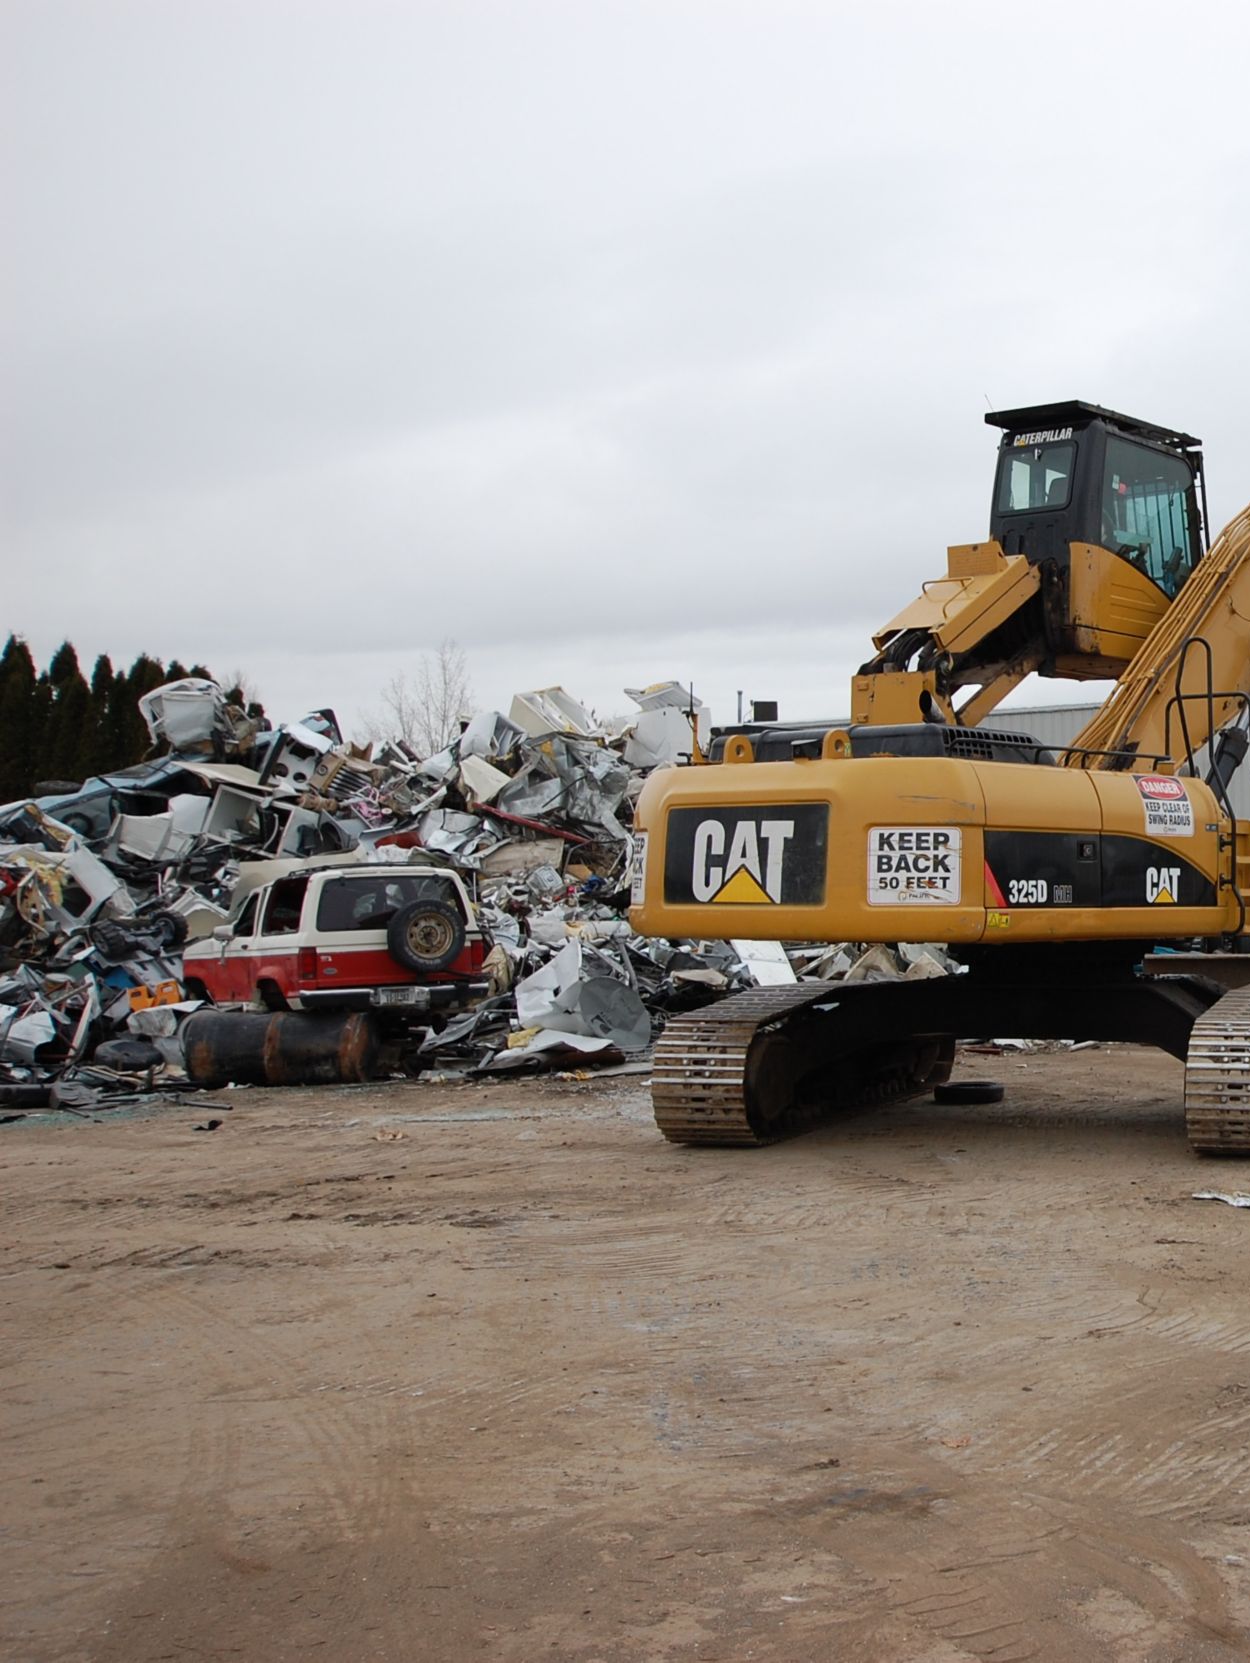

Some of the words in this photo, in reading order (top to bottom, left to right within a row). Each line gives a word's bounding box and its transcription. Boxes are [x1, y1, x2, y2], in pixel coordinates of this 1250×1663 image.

[1014, 427, 1073, 446] CATERPILLAR
[1141, 781, 1181, 794] DANGER
[1146, 801, 1161, 812] KEEP
[1162, 802, 1181, 813] CLEAR
[1182, 803, 1190, 814] OF
[1148, 814, 1168, 825] SWING
[1169, 815, 1191, 826] RADIUS
[878, 832, 950, 851] KEEP
[692, 819, 795, 904] CAT
[877, 854, 951, 873] BACK
[878, 877, 900, 889] 50
[905, 877, 950, 889] FEET
[1008, 880, 1047, 903] 325D
[1053, 885, 1073, 903] MH
[1146, 867, 1181, 903] CAT
